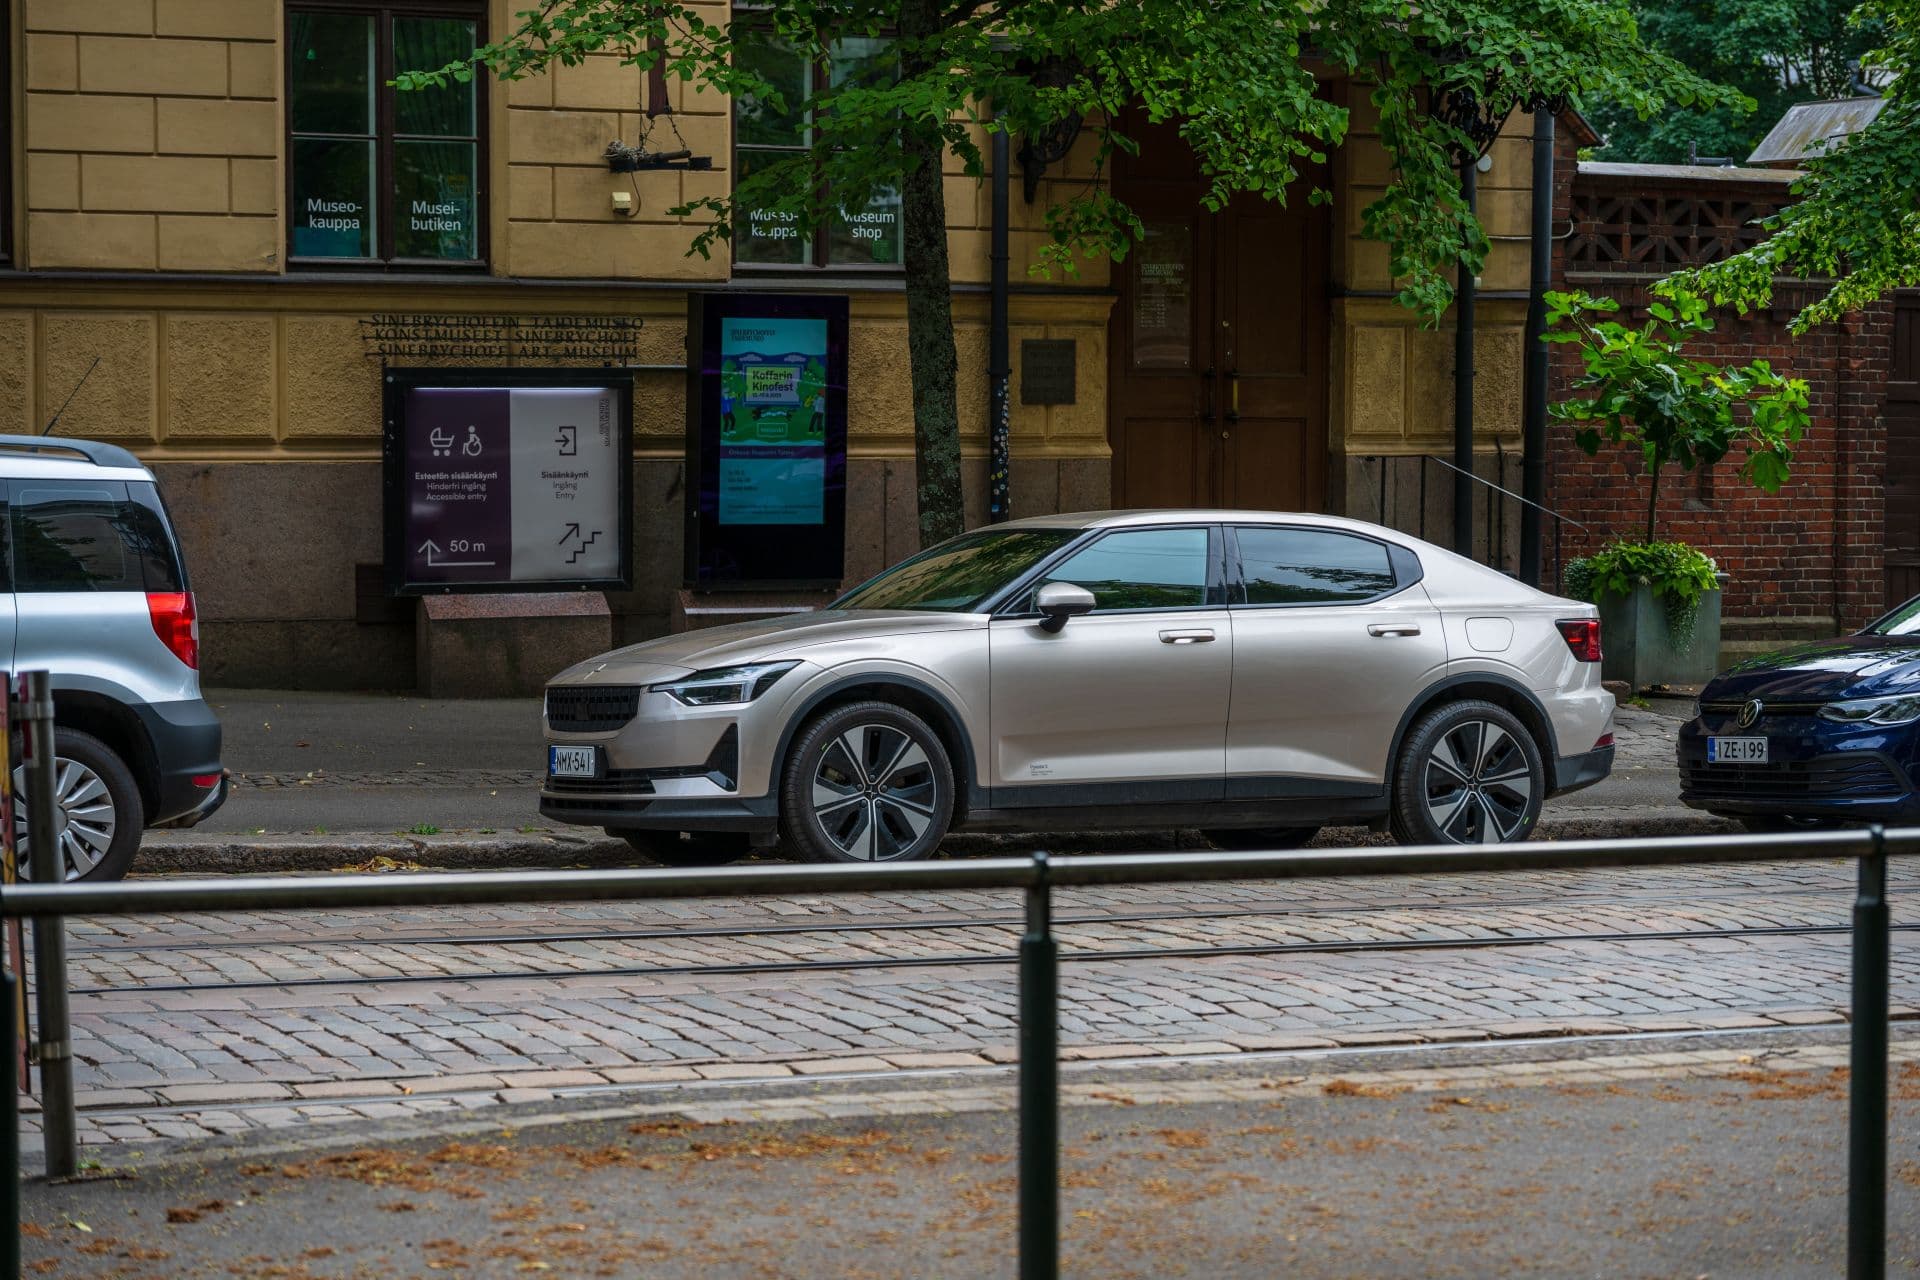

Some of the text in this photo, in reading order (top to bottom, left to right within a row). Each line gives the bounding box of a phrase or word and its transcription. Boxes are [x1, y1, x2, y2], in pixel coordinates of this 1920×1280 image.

[307, 198, 362, 213] Museo-
[412, 200, 460, 215] Musei-
[309, 214, 360, 232] kauppa
[411, 217, 461, 232] butiken
[852, 225, 883, 241] shop
[372, 314, 644, 330] SINEBRYCHOFFIN TAIDEMUSEO
[375, 328, 641, 344] KONSTMUSEET SINEBRYCHOFF
[378, 343, 638, 359] SINEBRYCHOFF ART MUSEUM
[752, 370, 793, 382] Koffarin
[752, 381, 794, 392] Kinofest
[426, 492, 487, 503] Accessible entry
[555, 491, 576, 502] Entry
[450, 540, 486, 553] 50 m
[556, 751, 590, 772] NMX-541
